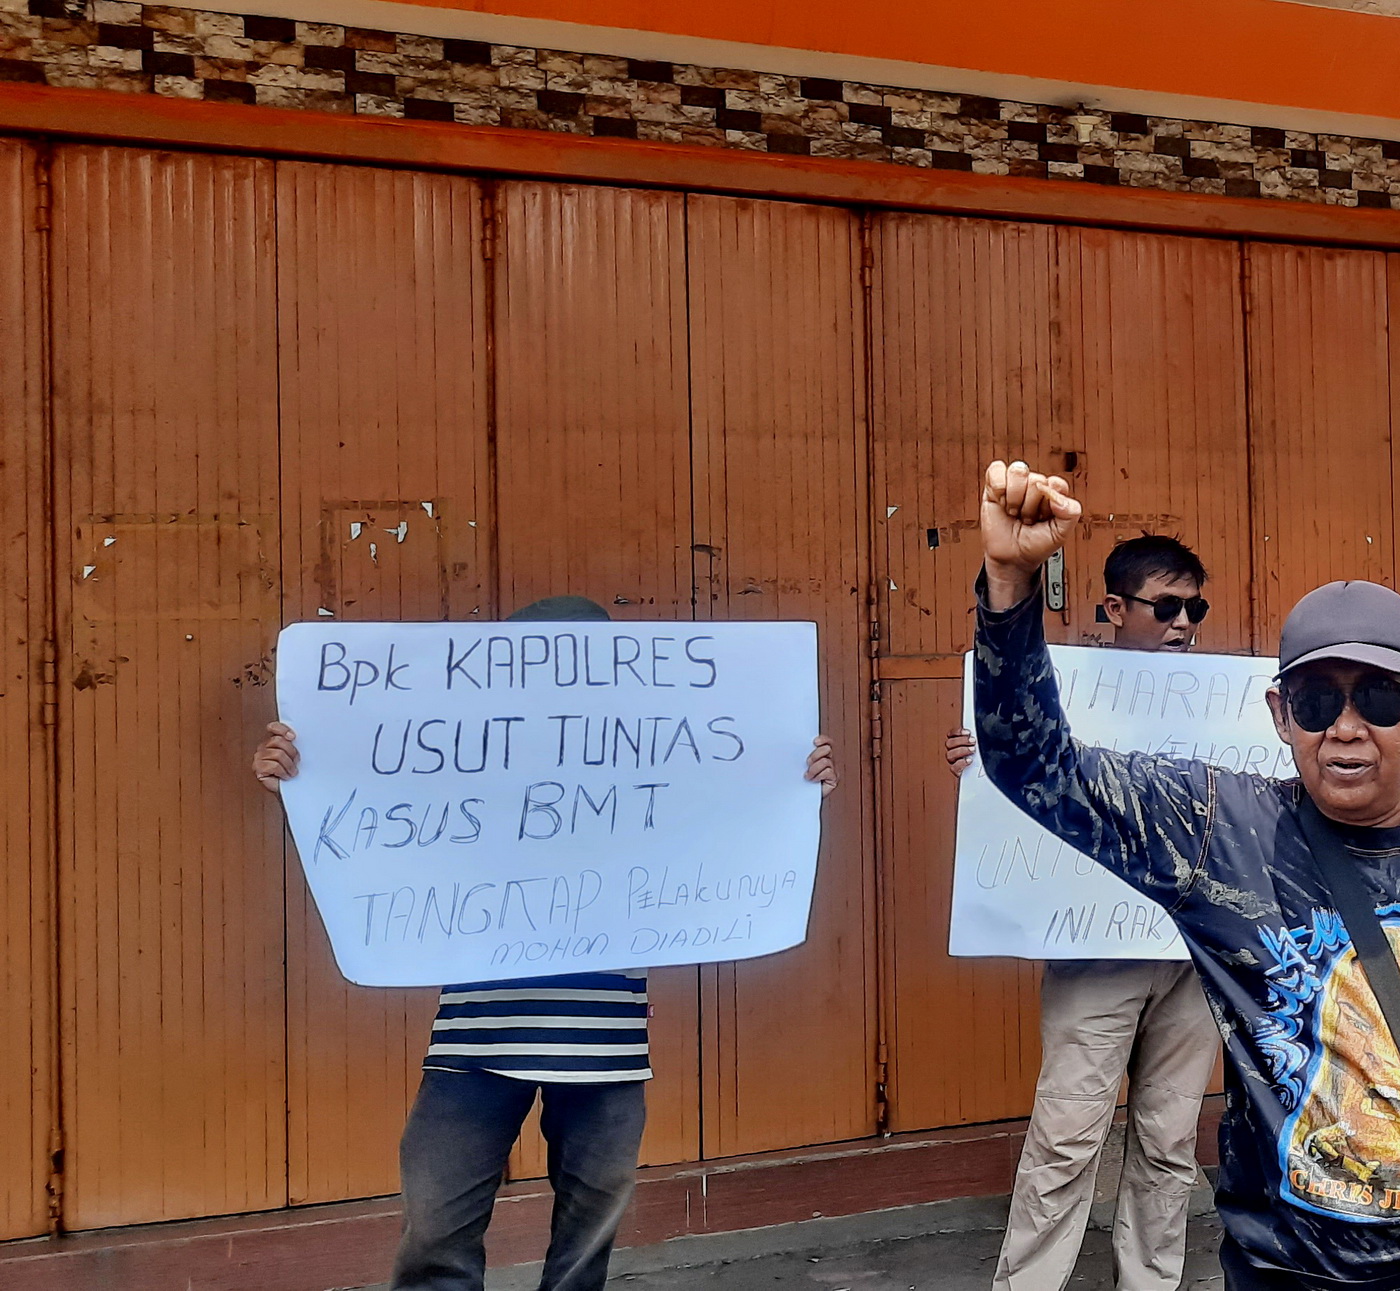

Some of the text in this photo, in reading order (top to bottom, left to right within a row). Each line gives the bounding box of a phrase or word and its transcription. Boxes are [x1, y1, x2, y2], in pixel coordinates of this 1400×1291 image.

[317, 634, 717, 705] Bpk KAPOLRES
[372, 714, 745, 775] USUT TUNTAS
[313, 781, 669, 865] KASUS BMT
[353, 870, 602, 947] TANGKAP
[1042, 903, 1097, 949] INI
